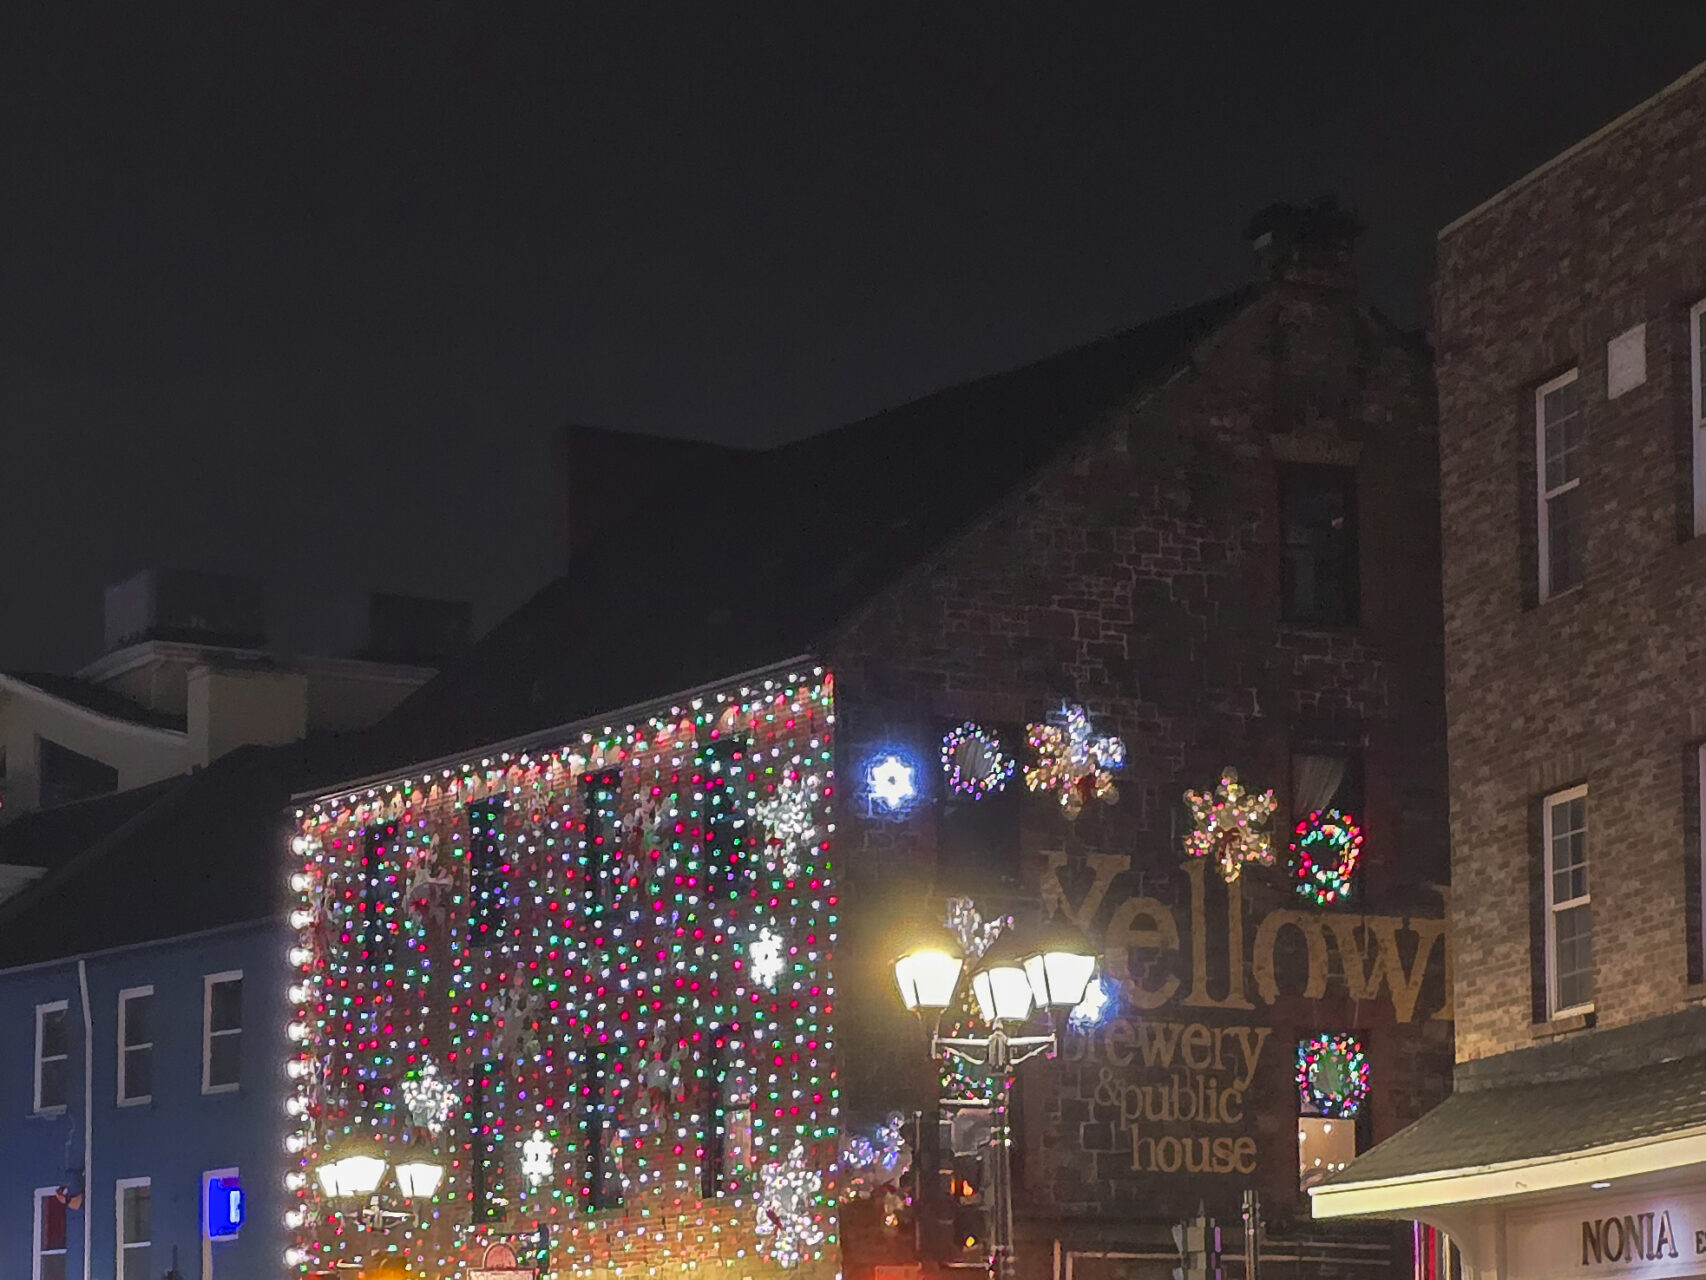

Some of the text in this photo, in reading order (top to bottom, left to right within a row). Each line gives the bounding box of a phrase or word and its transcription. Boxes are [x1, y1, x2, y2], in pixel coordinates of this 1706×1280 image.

[1039, 850, 1453, 1023] Yellow
[1130, 1123, 1257, 1174] house
[1581, 1209, 1706, 1267] NONIA E
